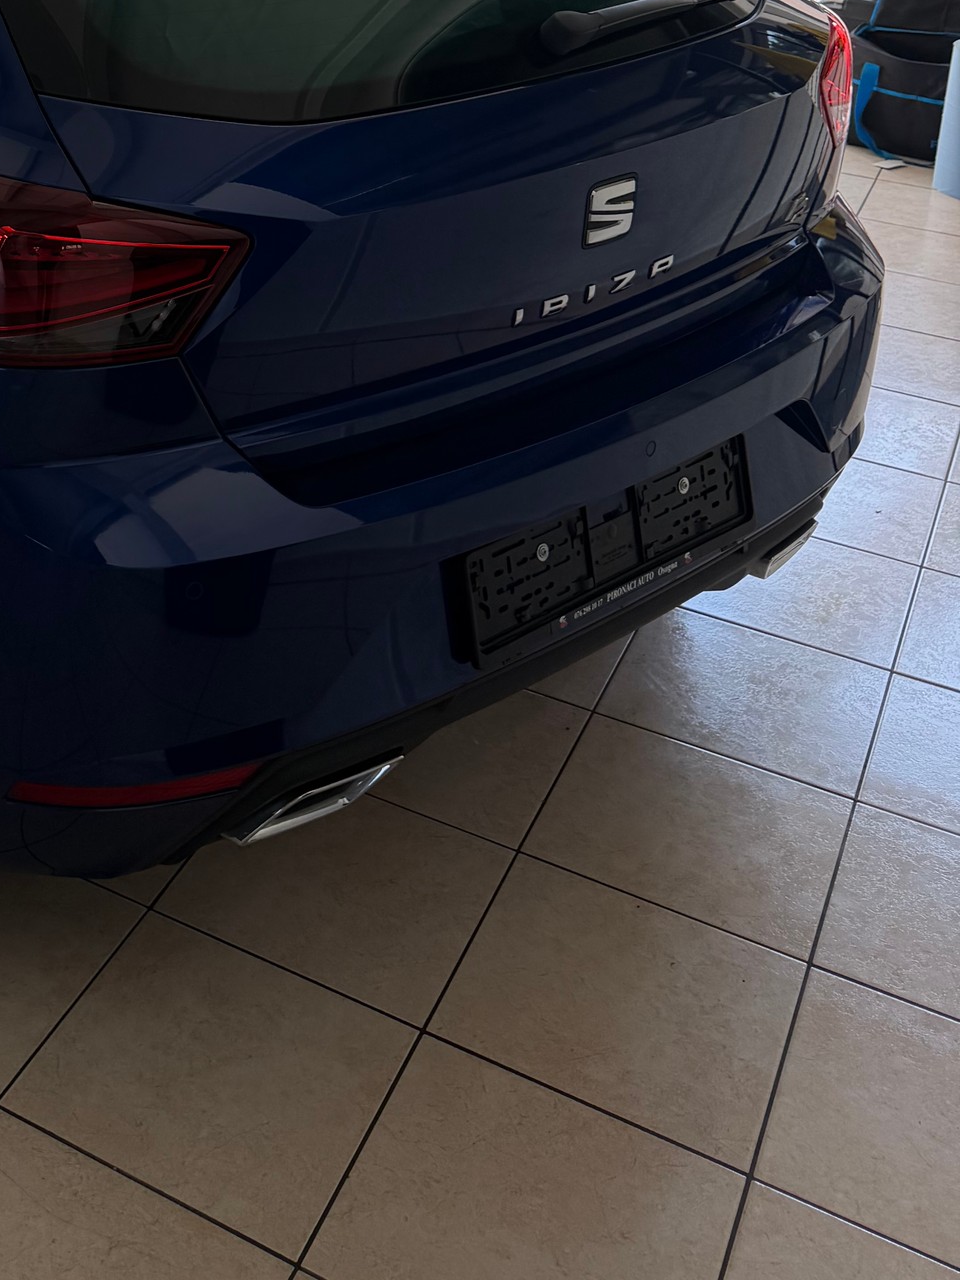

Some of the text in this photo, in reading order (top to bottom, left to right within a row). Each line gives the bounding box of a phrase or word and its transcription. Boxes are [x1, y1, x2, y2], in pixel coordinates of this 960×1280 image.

[513, 254, 674, 327] IBIZA
[606, 580, 638, 602] PIRONACI
[637, 571, 655, 587] AUTO
